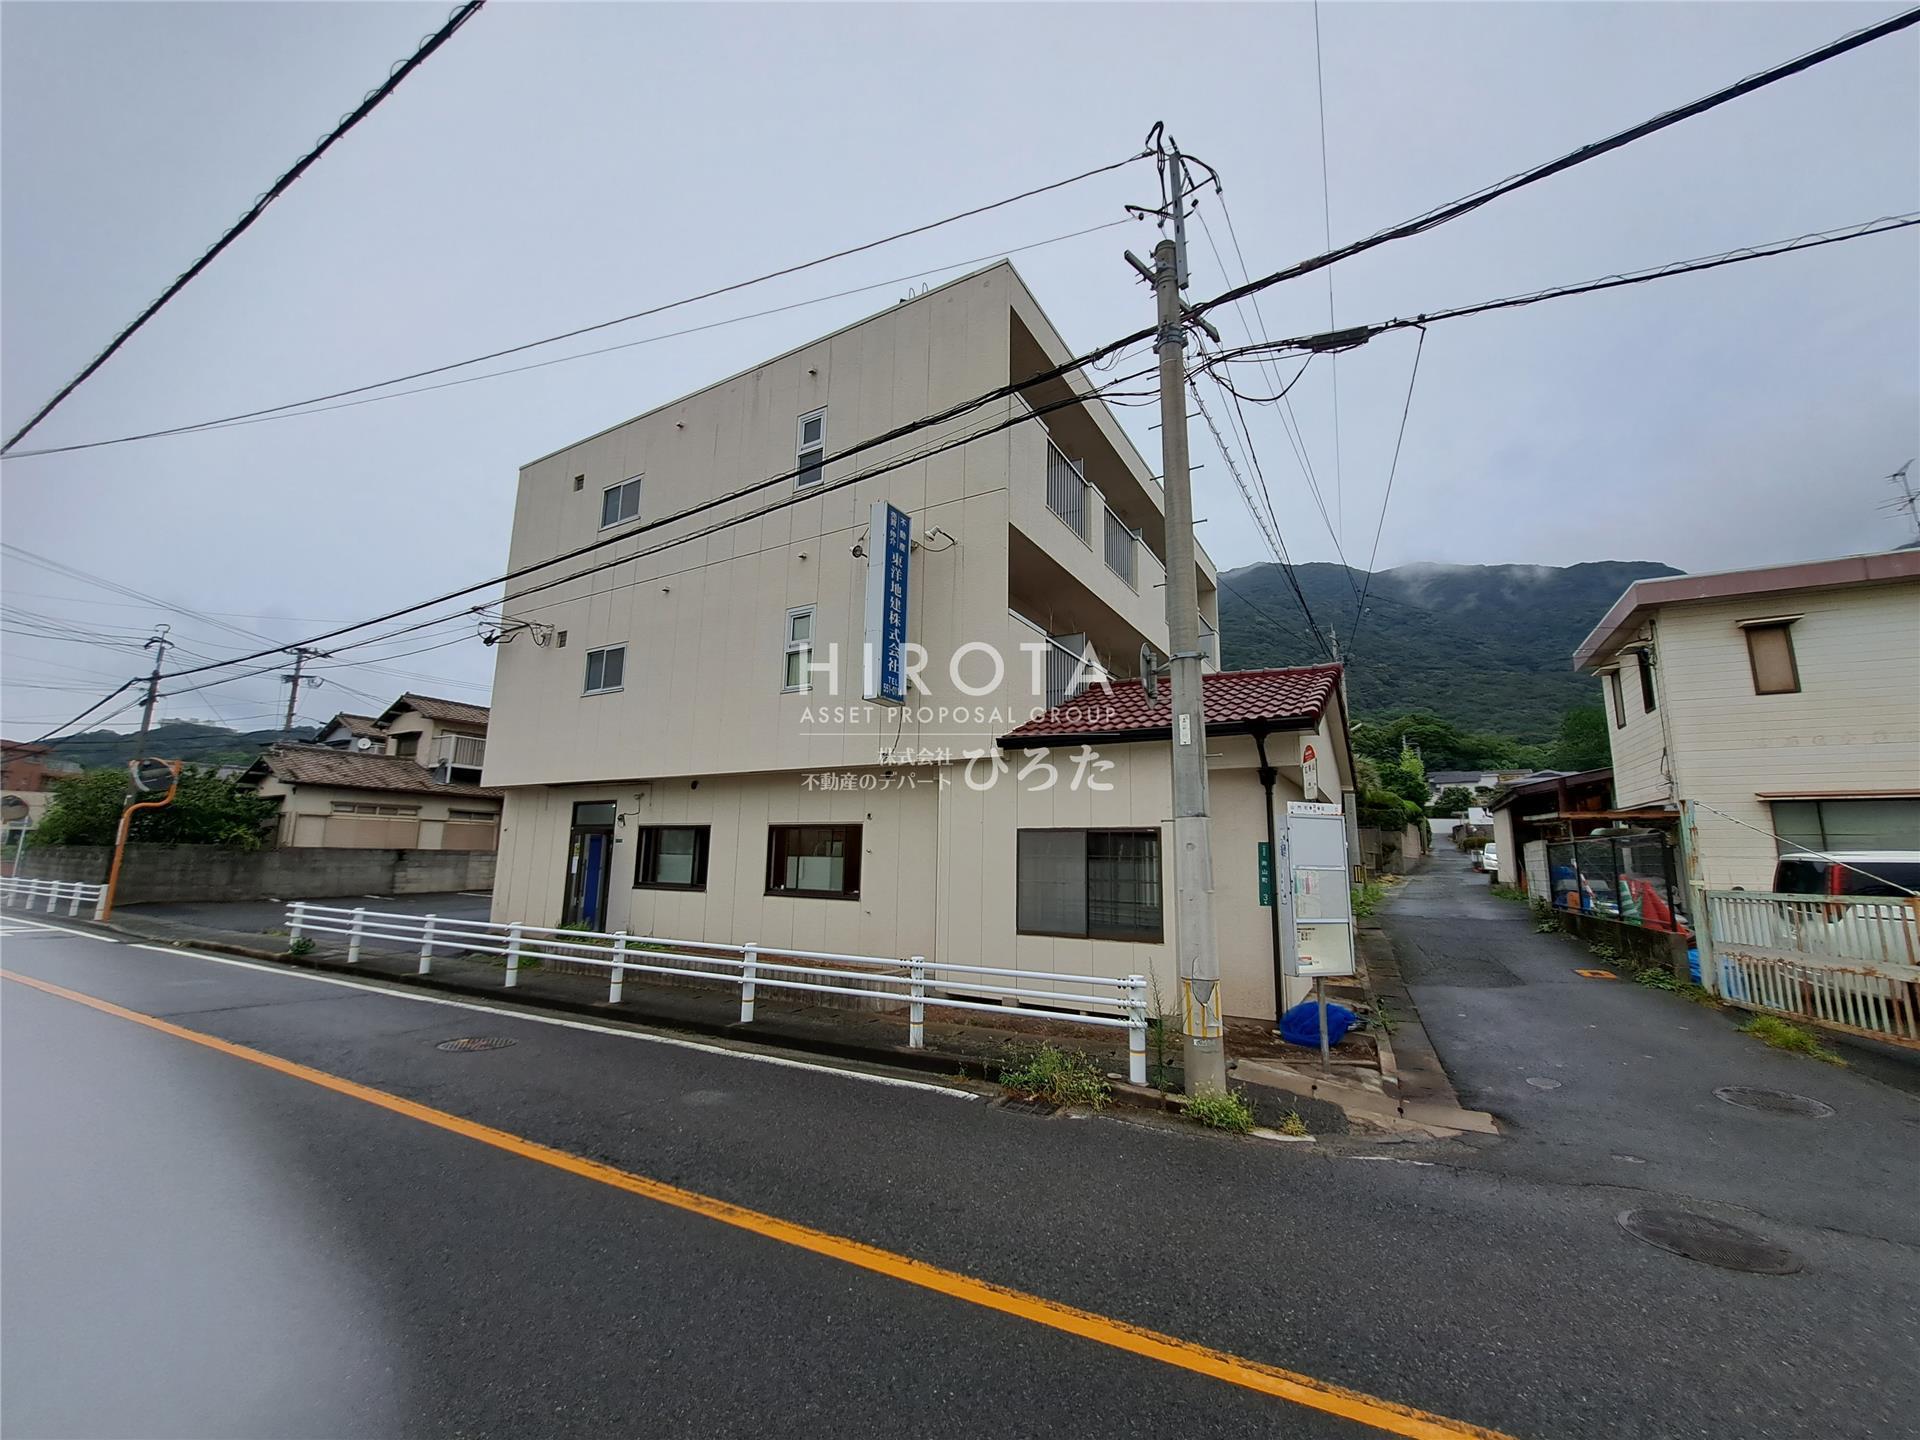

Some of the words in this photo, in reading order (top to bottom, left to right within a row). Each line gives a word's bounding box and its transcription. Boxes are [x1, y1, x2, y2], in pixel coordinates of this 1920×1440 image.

[888, 552, 902, 673] 東洋地建株式会社
[888, 676, 899, 686] TEL
